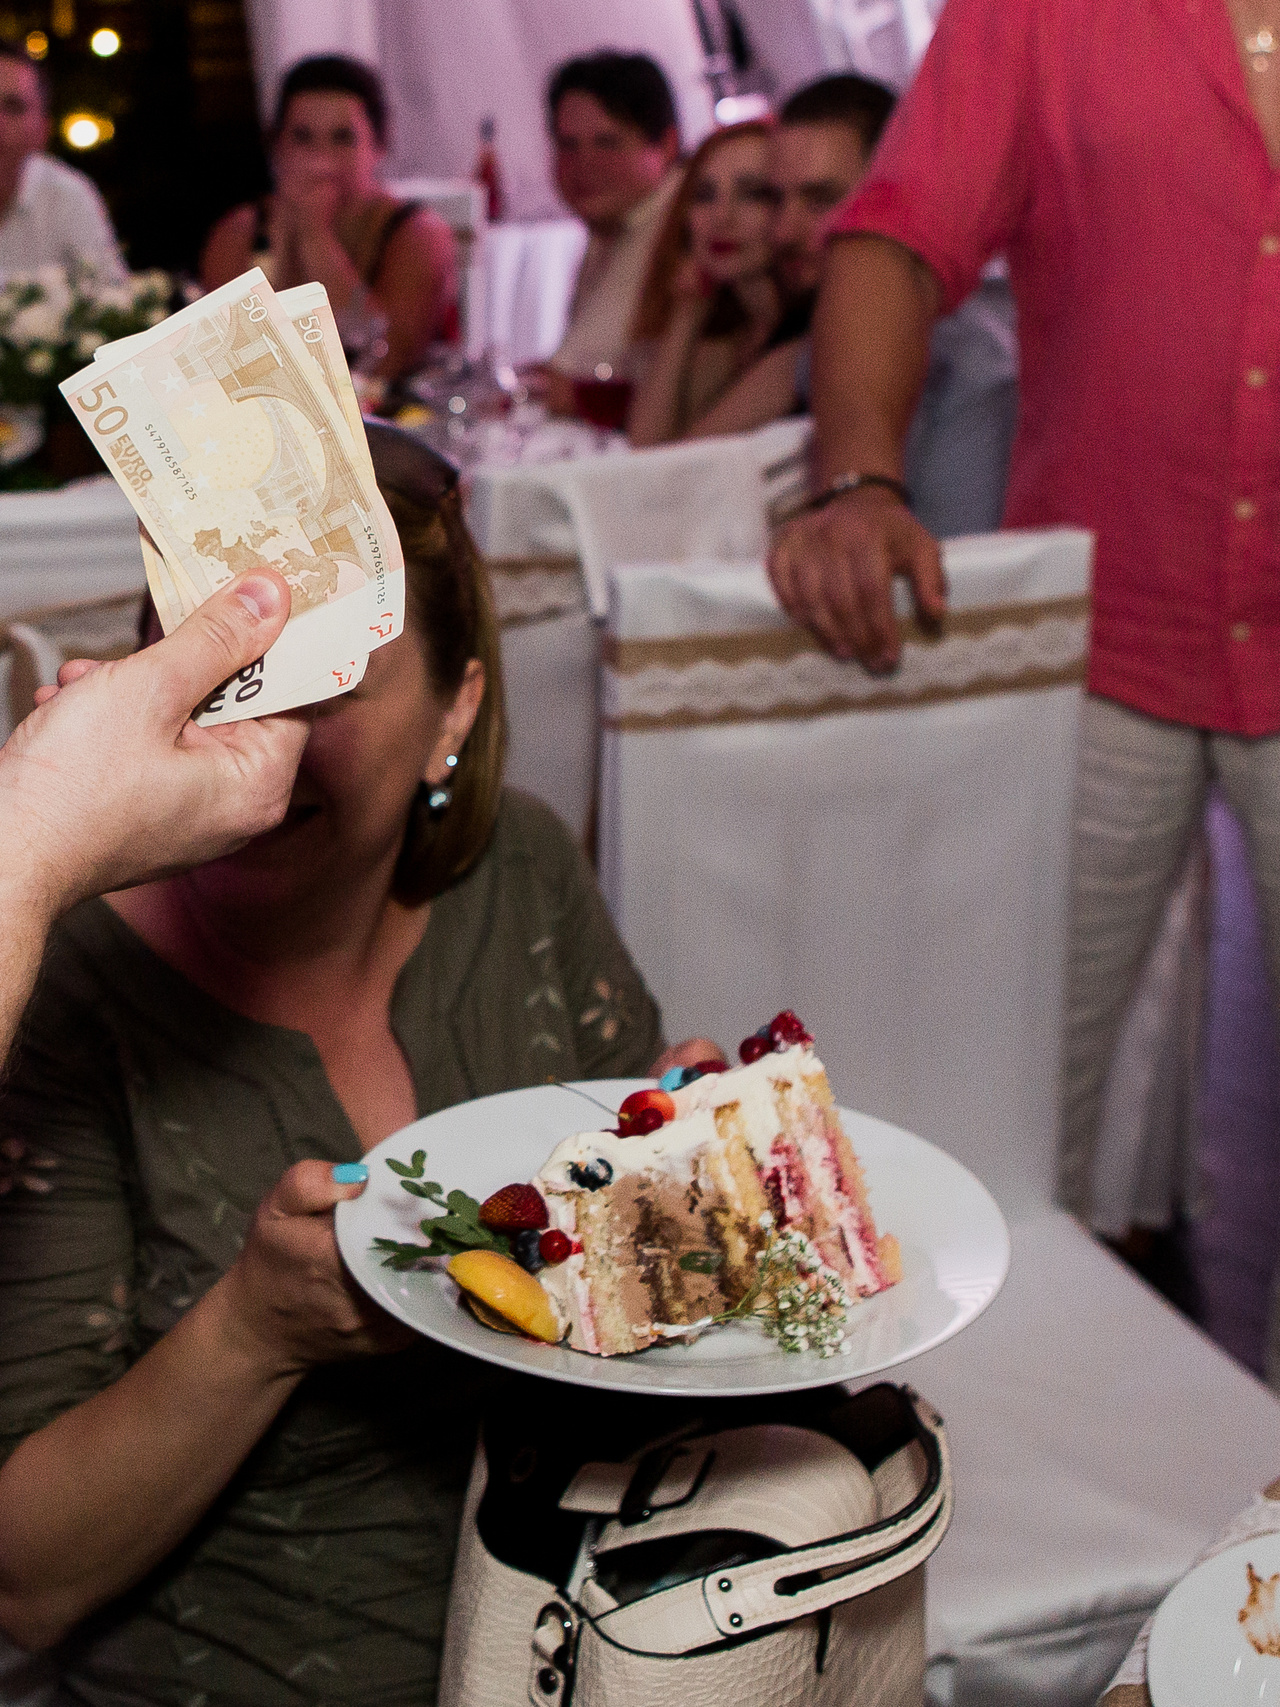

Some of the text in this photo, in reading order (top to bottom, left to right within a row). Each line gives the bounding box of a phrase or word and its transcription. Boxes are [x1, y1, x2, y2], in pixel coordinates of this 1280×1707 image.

[241, 293, 268, 323] 50
[299, 315, 323, 343] 50
[76, 380, 154, 482] 50 EURO
[144, 423, 198, 501] S47976587125
[363, 525, 386, 605] S47976587125
